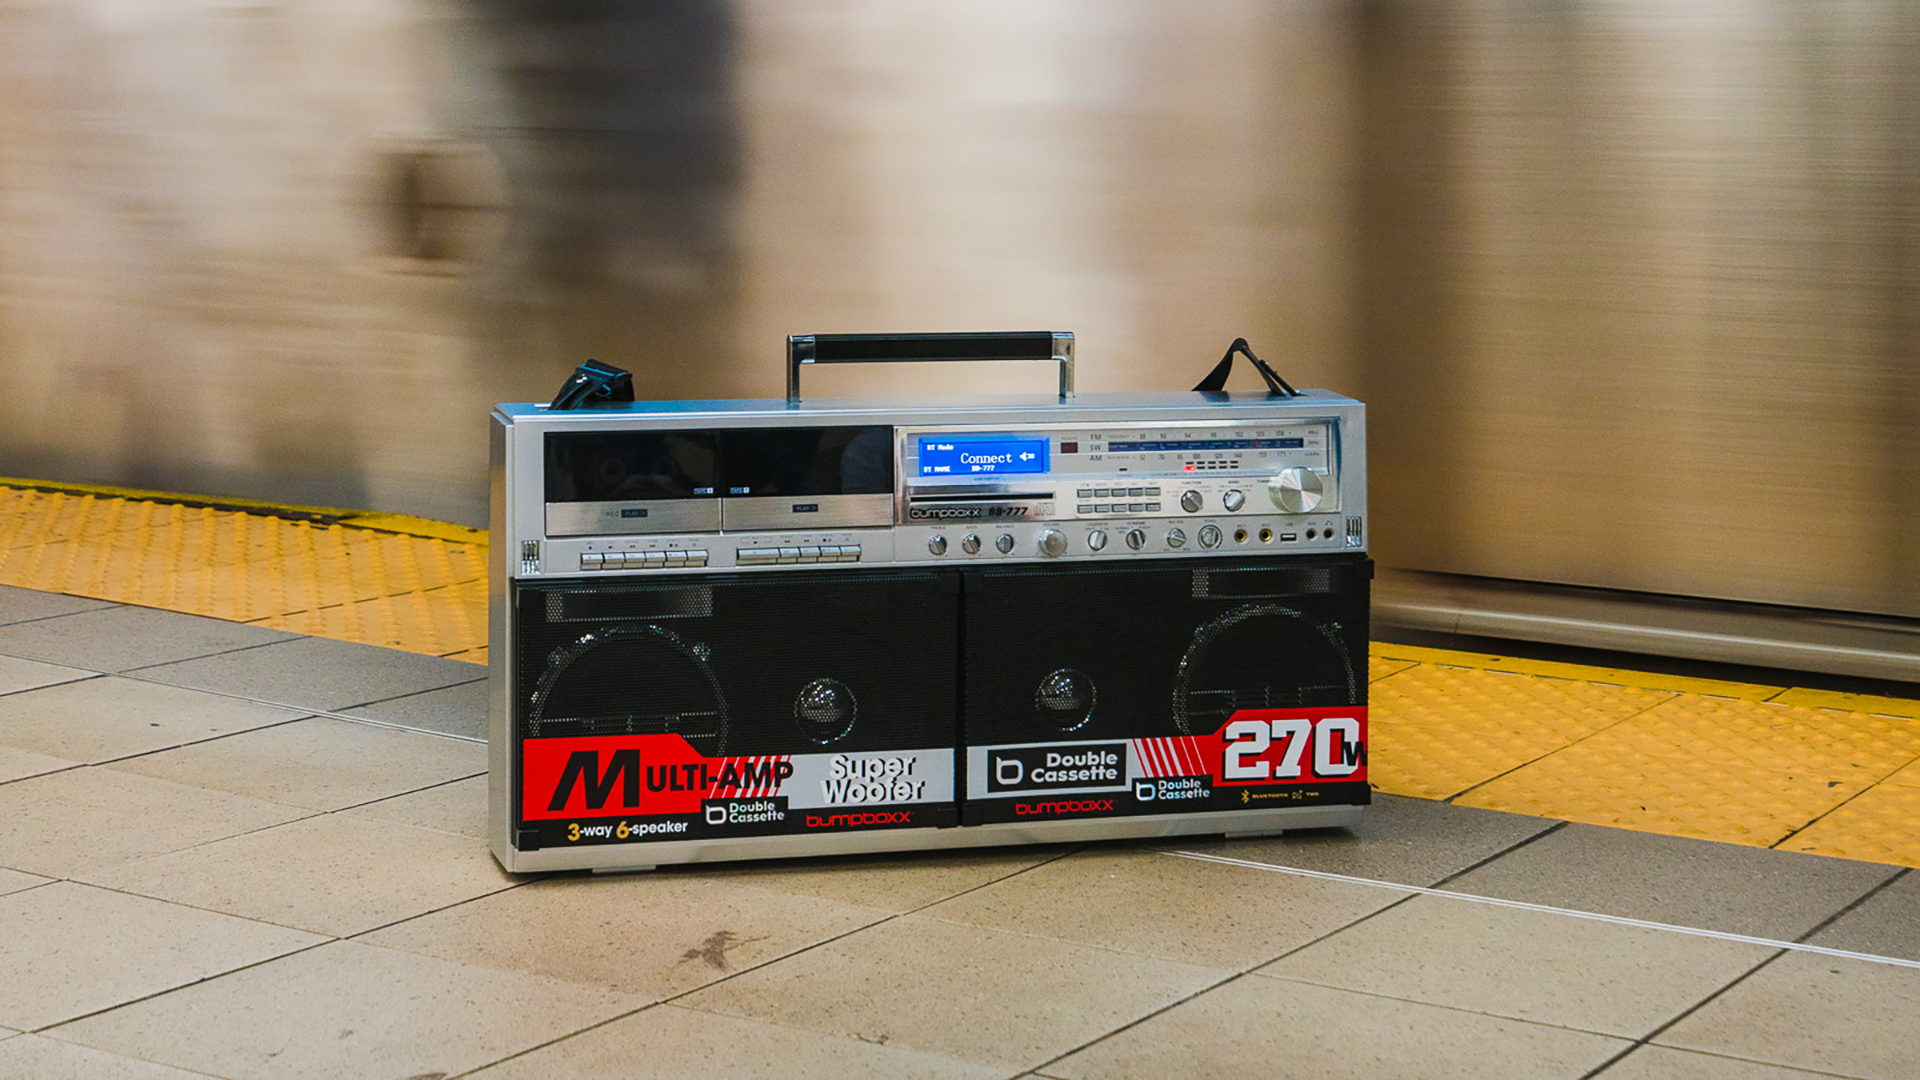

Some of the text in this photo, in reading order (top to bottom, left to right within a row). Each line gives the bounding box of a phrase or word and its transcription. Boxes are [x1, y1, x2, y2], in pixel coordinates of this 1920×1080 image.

[1090, 444, 1102, 452] SW
[960, 452, 1012, 464] Connect
[1089, 454, 1103, 462] AM
[909, 506, 982, 520] bumpboxx
[1046, 751, 1118, 768] Double
[829, 754, 917, 783] Super
[1030, 766, 1118, 783] Cassette
[820, 777, 926, 805] Woofer
[1158, 778, 1201, 790] Double
[1158, 788, 1211, 800] Cassette
[729, 801, 776, 814] Double
[1015, 799, 1114, 815] bumpboxx
[729, 808, 785, 824] Cassette
[806, 811, 911, 828] bumpboxx
[567, 820, 688, 842] 3-way 6-speaker
